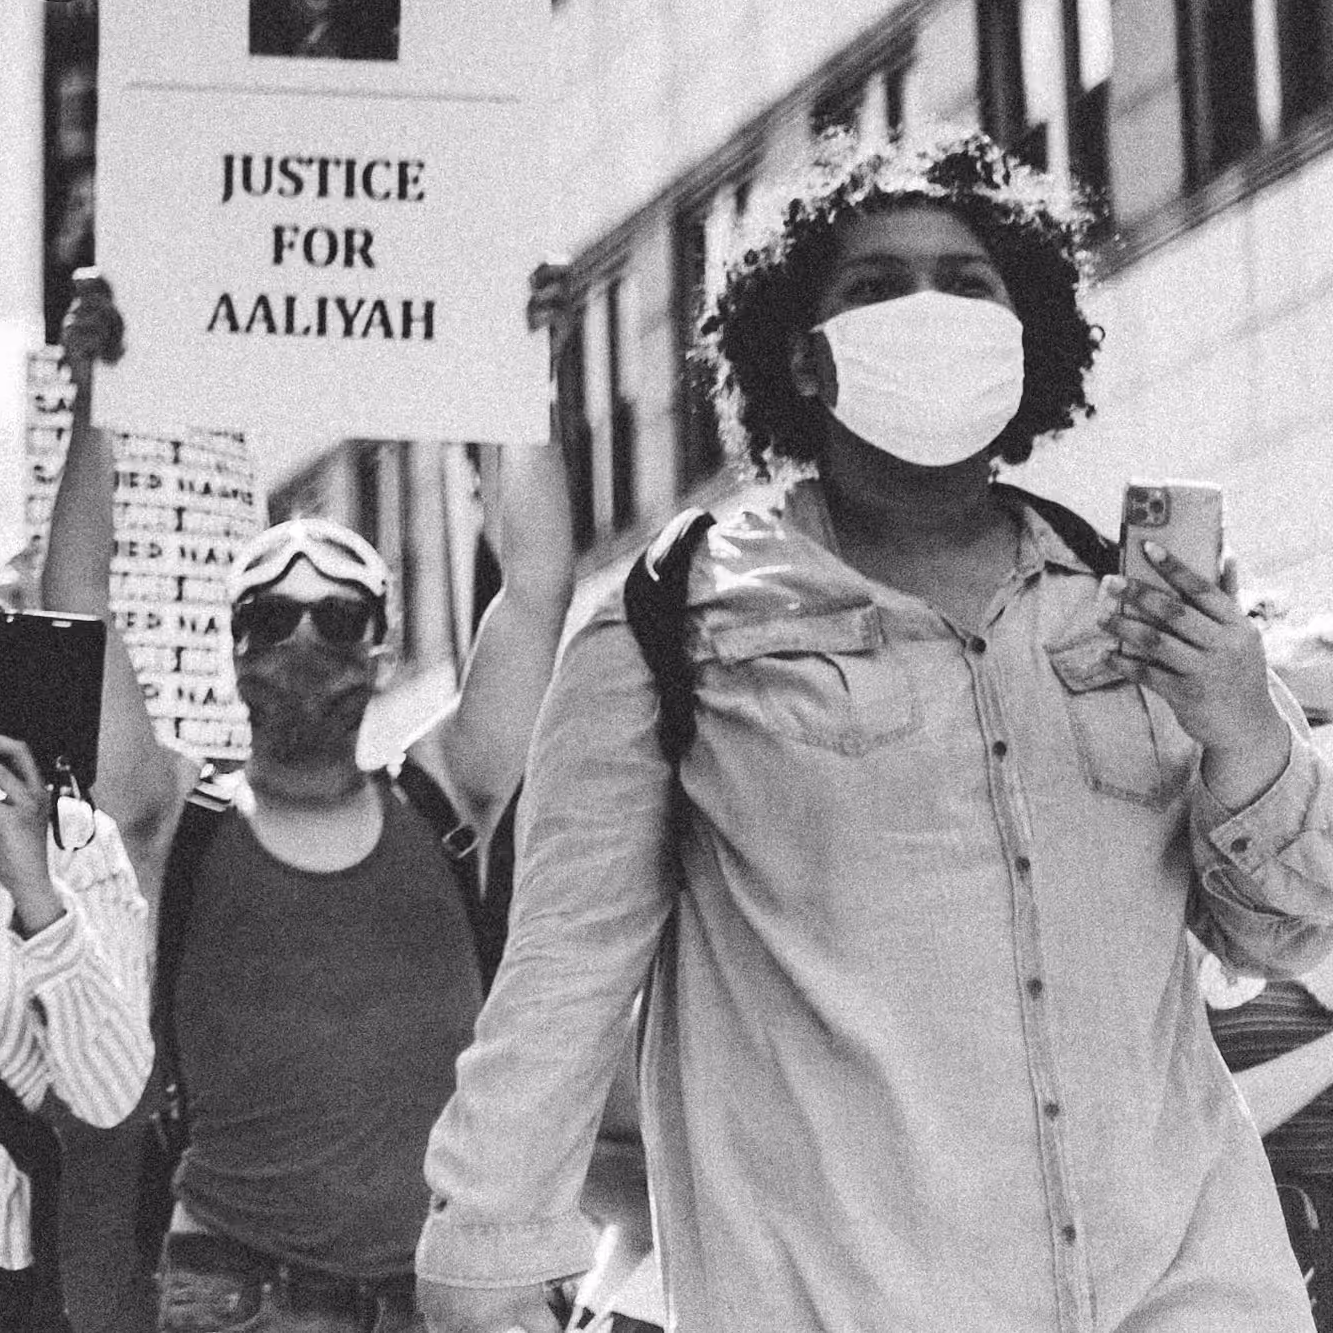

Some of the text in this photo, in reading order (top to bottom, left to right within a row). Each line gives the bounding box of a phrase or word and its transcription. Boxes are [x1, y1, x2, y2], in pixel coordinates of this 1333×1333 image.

[222, 154, 425, 203] JUSTICE
[273, 225, 375, 268] FOR
[206, 293, 435, 341] AALIYAH
